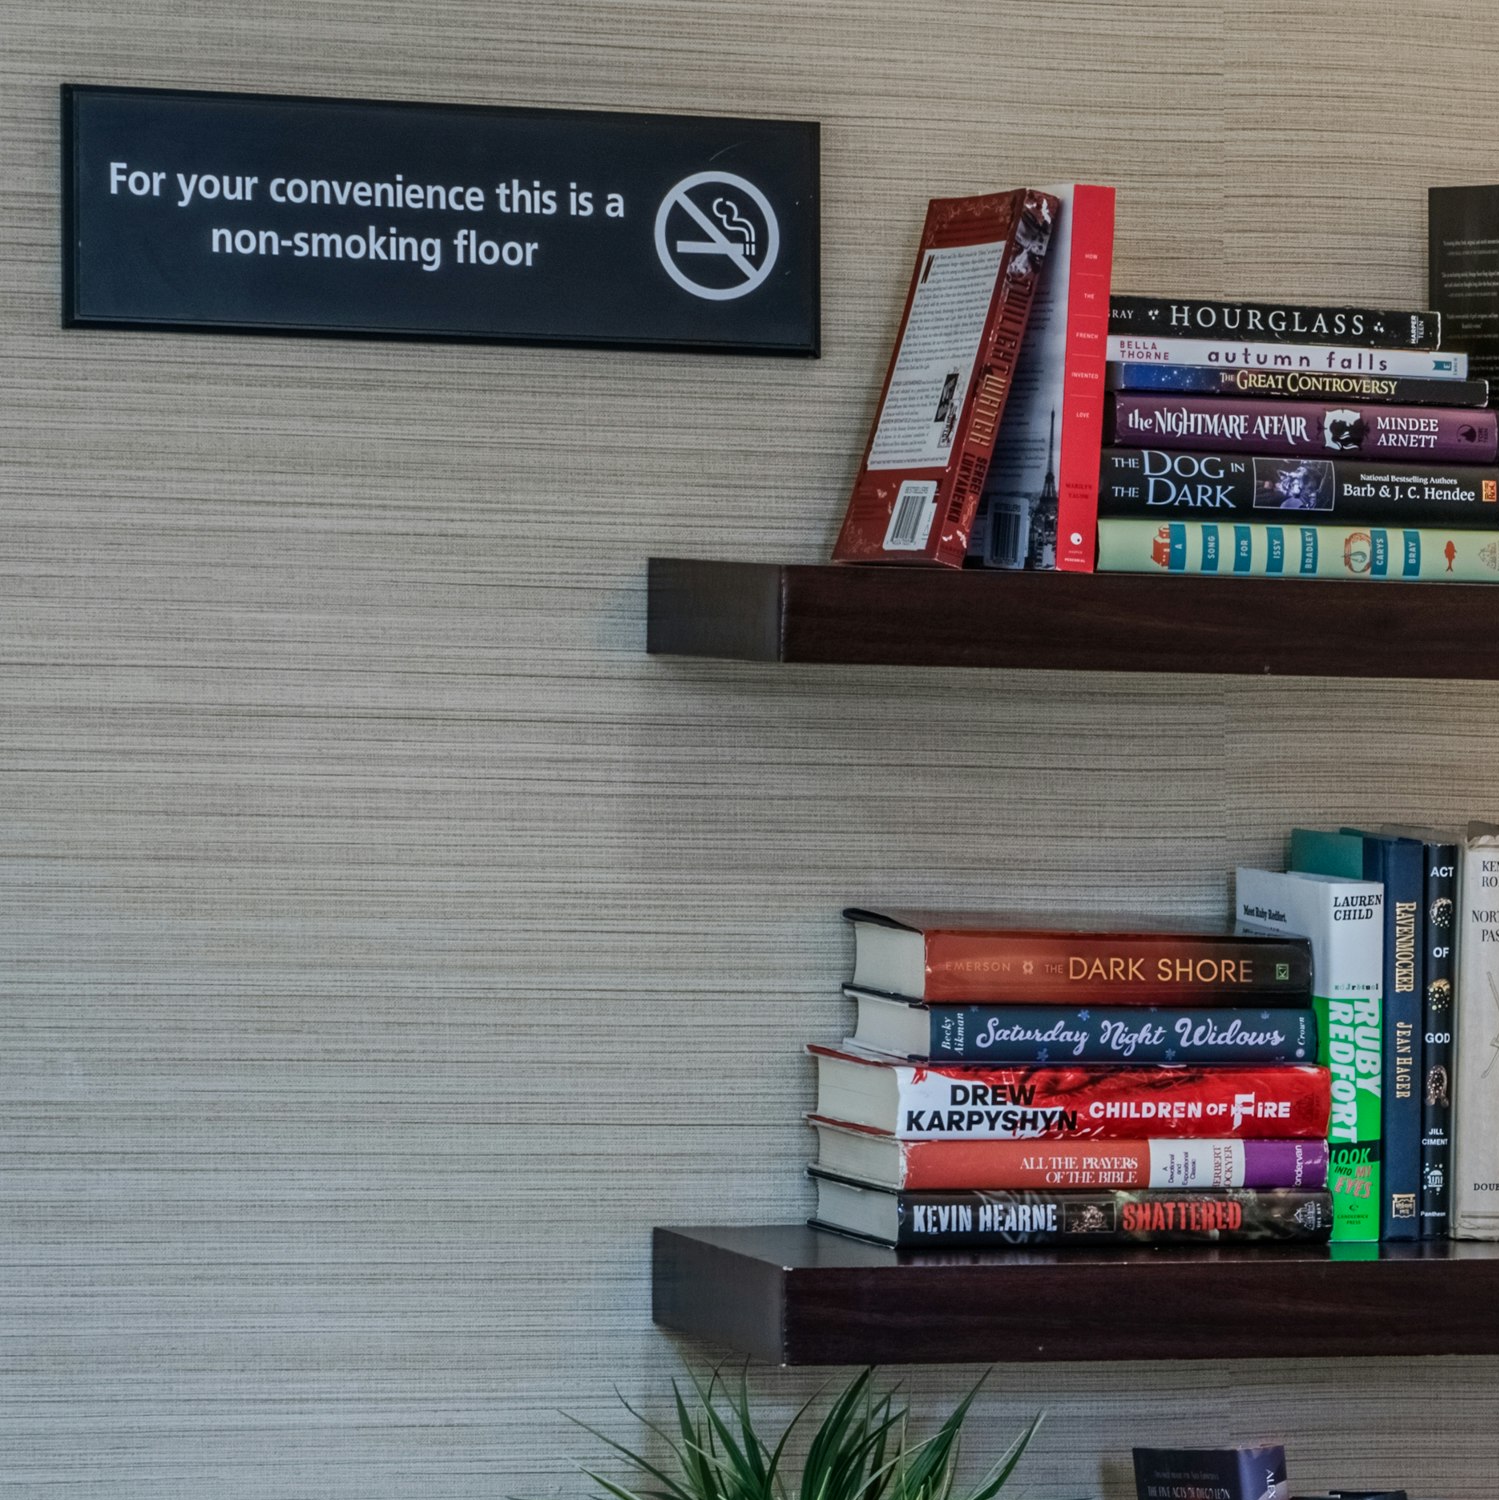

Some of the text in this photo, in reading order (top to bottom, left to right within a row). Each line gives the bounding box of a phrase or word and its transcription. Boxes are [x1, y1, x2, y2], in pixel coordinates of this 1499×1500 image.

[110, 162, 626, 218] For your convenience this is a
[212, 225, 540, 272] non-smoking floor
[1170, 305, 1365, 336] HOURGLASS
[1119, 341, 1158, 351] BELLA
[1120, 350, 1170, 361] THORNE
[1208, 347, 1388, 372] autumn falls
[1071, 371, 1099, 379] INVENTED
[1236, 369, 1398, 396] GREAT CONTROVERSY
[1154, 406, 1312, 446] NIGHTMARE AFFAIR
[1377, 417, 1439, 432] MINDEE
[1377, 433, 1438, 448] ARNETT
[1111, 449, 1245, 479] THE DOG IN
[1360, 473, 1458, 485] National Bestselling Authors
[1111, 477, 1237, 508] THE DARK
[1343, 483, 1475, 501] Barb J. Hendee
[1207, 531, 1314, 569] SONG FOR ISSY BRADLEY
[1376, 538, 1416, 566] CARYS BRAY
[1333, 893, 1383, 908] LAUREN
[1333, 908, 1374, 921] CHILD
[1424, 865, 1455, 1044] ACT OF GOD
[945, 957, 1253, 982] EMERSON THE DARK SHORE
[941, 1016, 956, 1050] Becky
[976, 1017, 1286, 1057] Saturday Night Widows
[1354, 998, 1382, 1099] RUBY
[950, 1084, 1037, 1106] DREW
[906, 1110, 1078, 1132] KARPYSHYN
[1089, 1101, 1227, 1119] CHILDREN OF
[1428, 1128, 1443, 1136] JILL
[1020, 1156, 1138, 1170] ALL THE PRAYERS
[1334, 1165, 1352, 1176] INTO
[1046, 1171, 1138, 1184] OF THE BIBLE
[913, 1200, 1242, 1234] KEVIN HEARNE SHATTERED
